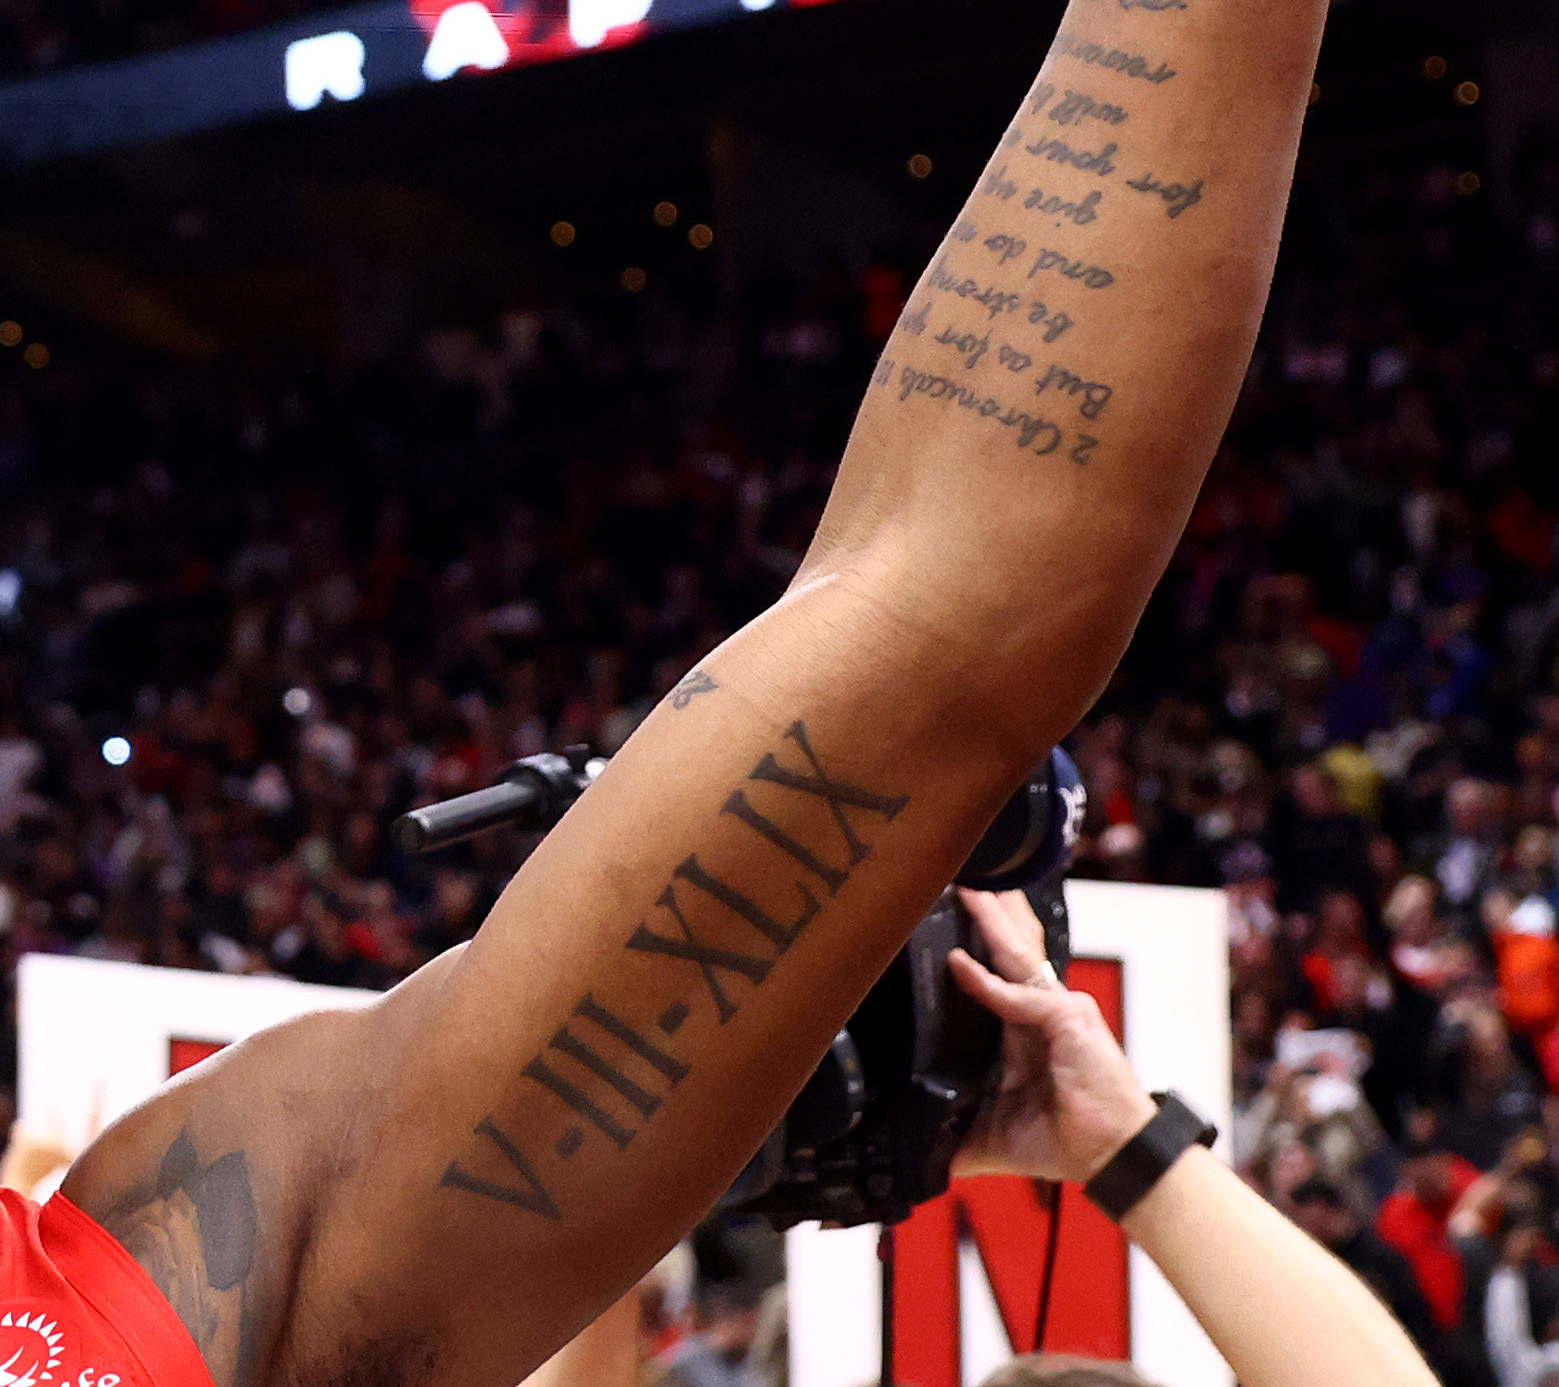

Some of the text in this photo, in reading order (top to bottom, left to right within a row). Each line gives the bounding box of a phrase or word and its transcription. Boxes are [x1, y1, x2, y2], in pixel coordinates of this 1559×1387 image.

[1048, 88, 1128, 126] will
[1026, 136, 1118, 176] your
[1024, 189, 1102, 228] give
[1126, 171, 1205, 219] for
[984, 232, 1115, 290] and do
[1028, 301, 1075, 344] be
[934, 324, 994, 369] for
[999, 344, 1032, 372] as
[1035, 363, 1113, 422] But
[1069, 432, 1099, 466] 2
